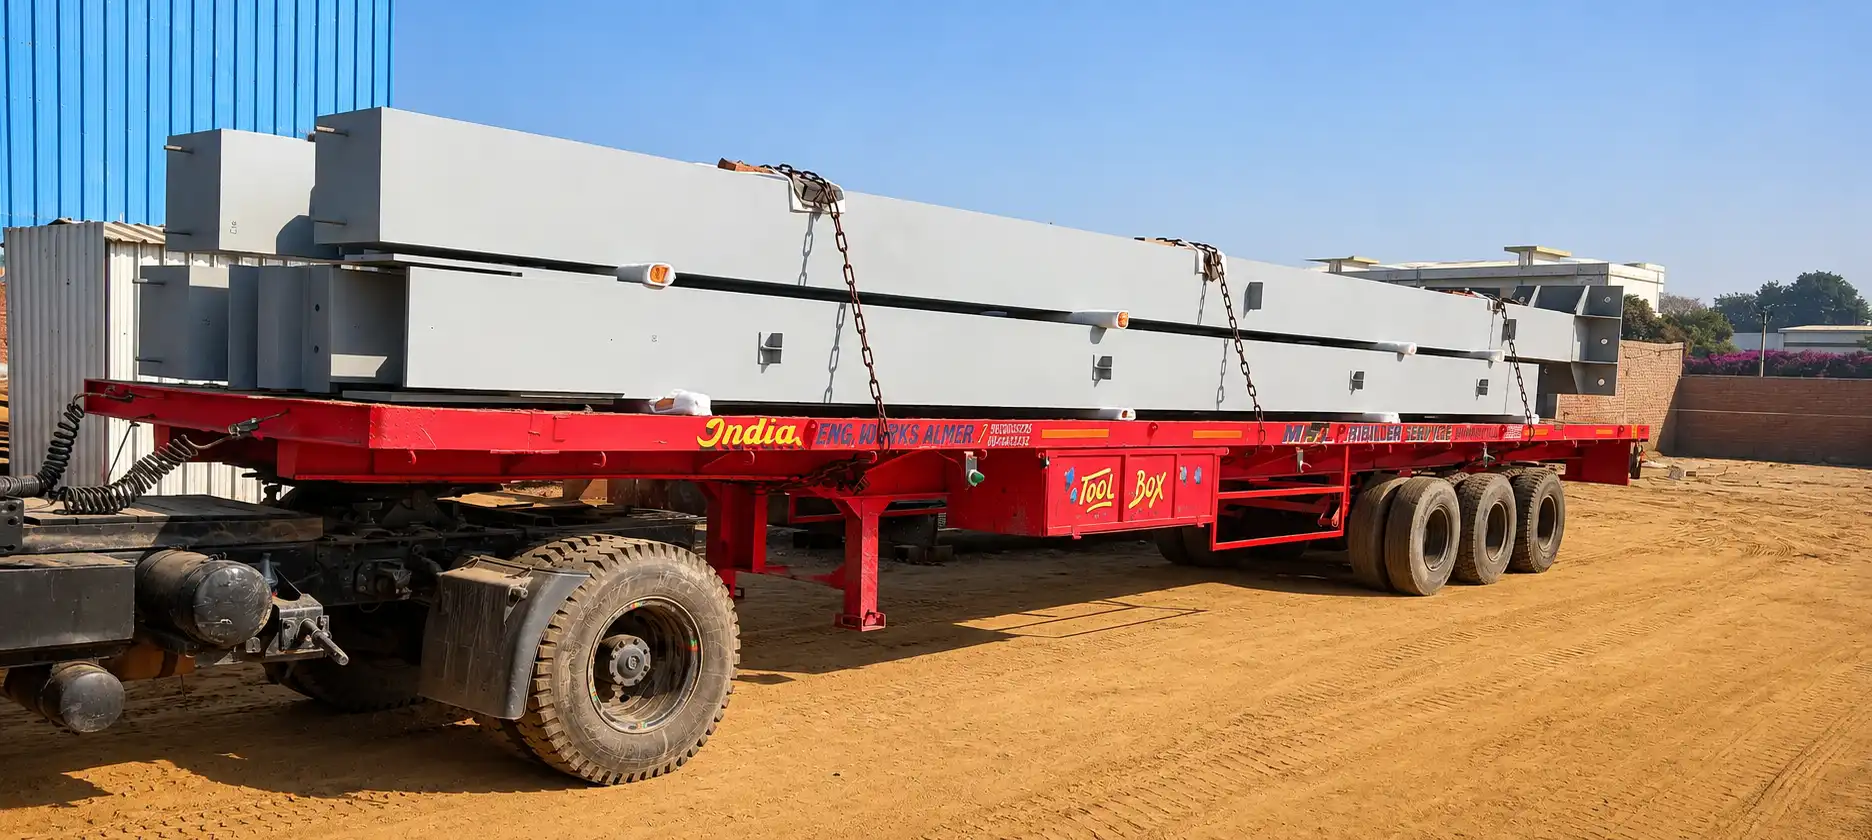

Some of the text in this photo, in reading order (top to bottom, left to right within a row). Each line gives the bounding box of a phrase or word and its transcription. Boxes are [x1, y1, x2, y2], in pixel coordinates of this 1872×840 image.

[859, 423, 920, 446] WRKS
[1078, 467, 1167, 509] TOOL BOX
